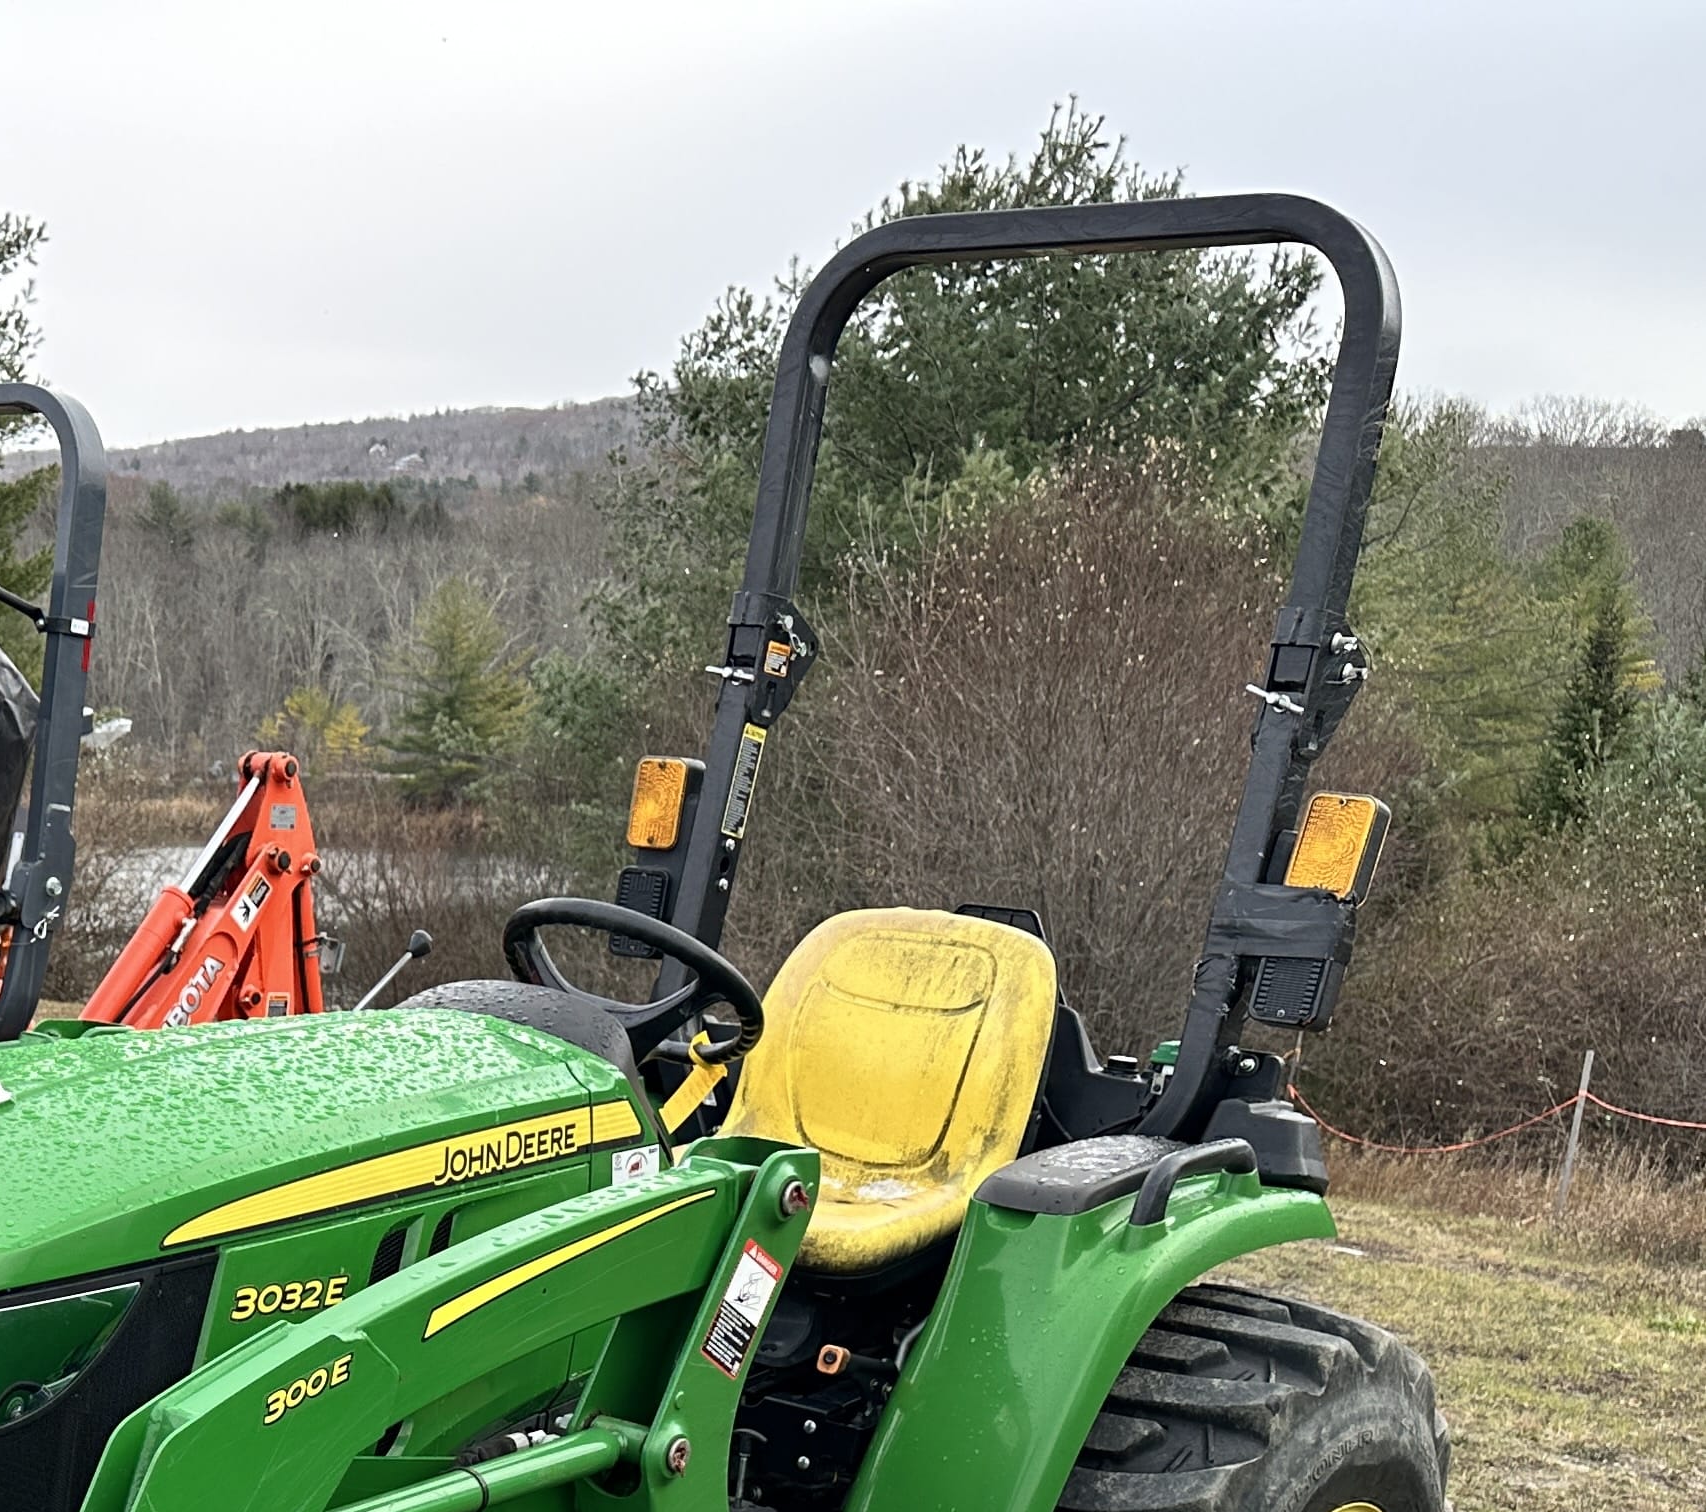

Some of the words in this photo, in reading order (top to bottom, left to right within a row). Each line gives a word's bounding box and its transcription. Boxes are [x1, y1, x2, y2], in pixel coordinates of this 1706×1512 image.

[164, 954, 225, 1028] BOTA
[434, 1140, 501, 1182] JOHN
[506, 1123, 576, 1164] DEERE
[230, 1275, 348, 1321] 3032E
